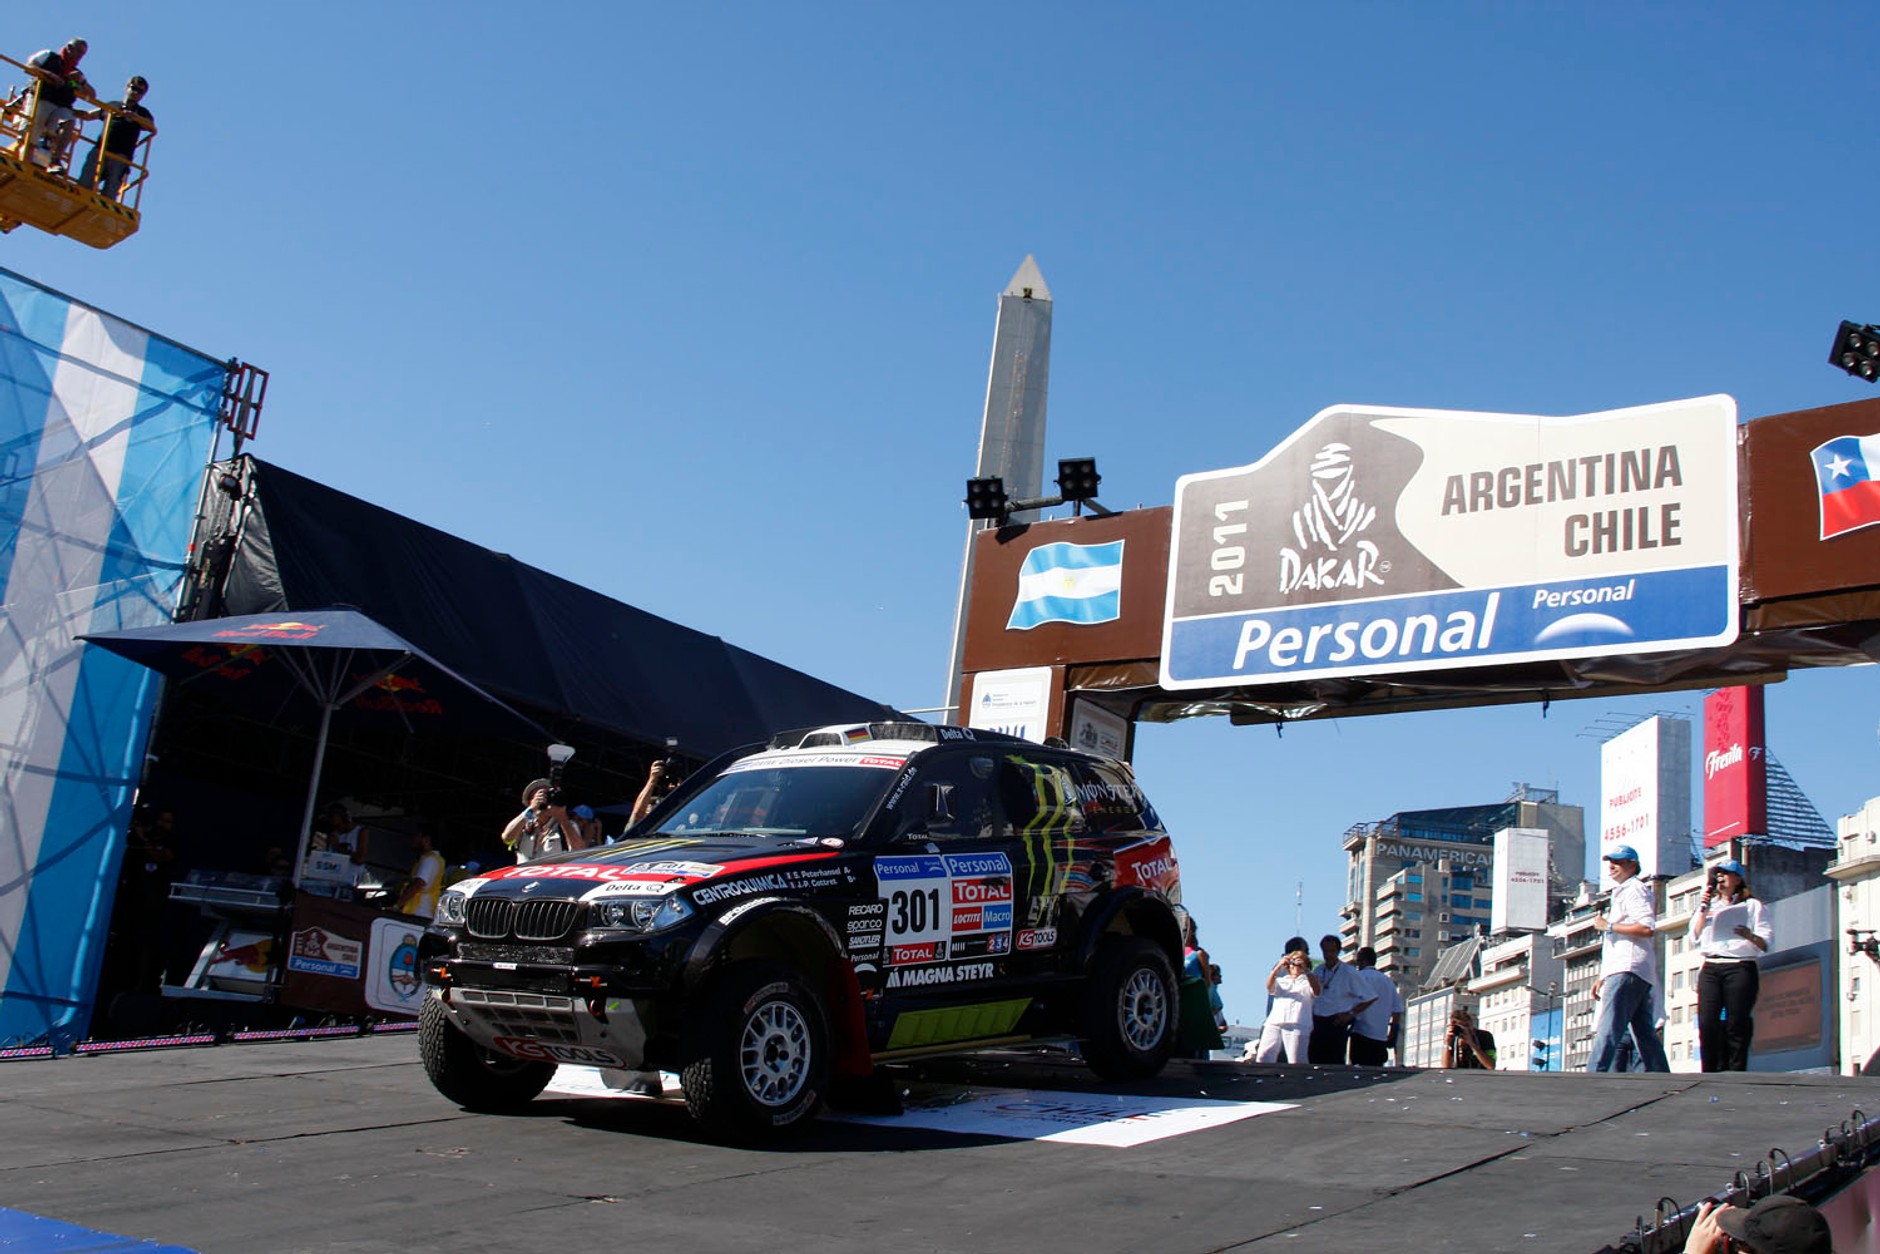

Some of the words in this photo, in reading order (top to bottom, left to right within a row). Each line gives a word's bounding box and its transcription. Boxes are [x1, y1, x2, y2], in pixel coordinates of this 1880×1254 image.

[1441, 445, 1682, 516] ARGENTINA
[1564, 502, 1681, 557] CHILE
[1209, 500, 1248, 596] 2011
[1279, 540, 1385, 594] DAKAR
[1532, 579, 1636, 609] Personal
[1232, 592, 1501, 670] Personal
[941, 728, 963, 741] Delta
[817, 756, 859, 764] Power
[1705, 743, 1743, 780] Fresita
[1605, 813, 1649, 841] 4556-1701
[504, 866, 621, 881] TOTAL
[877, 863, 920, 874] Personal
[950, 856, 1008, 873] Personal
[1132, 857, 1172, 884] TOTAL
[605, 883, 641, 892] Delta
[693, 873, 788, 906] CENTROQUIMICA
[954, 881, 1010, 900] TOTAL
[848, 903, 883, 916] RECARO
[891, 888, 940, 935] 301
[985, 910, 1011, 923] Macro
[847, 919, 882, 932] sparco
[953, 913, 981, 925] LOCTITE
[851, 951, 879, 962] Personal
[894, 948, 933, 961] TOTAL
[294, 959, 337, 972] Personal
[903, 967, 954, 987] MAGNA
[956, 963, 994, 982] STEYR
